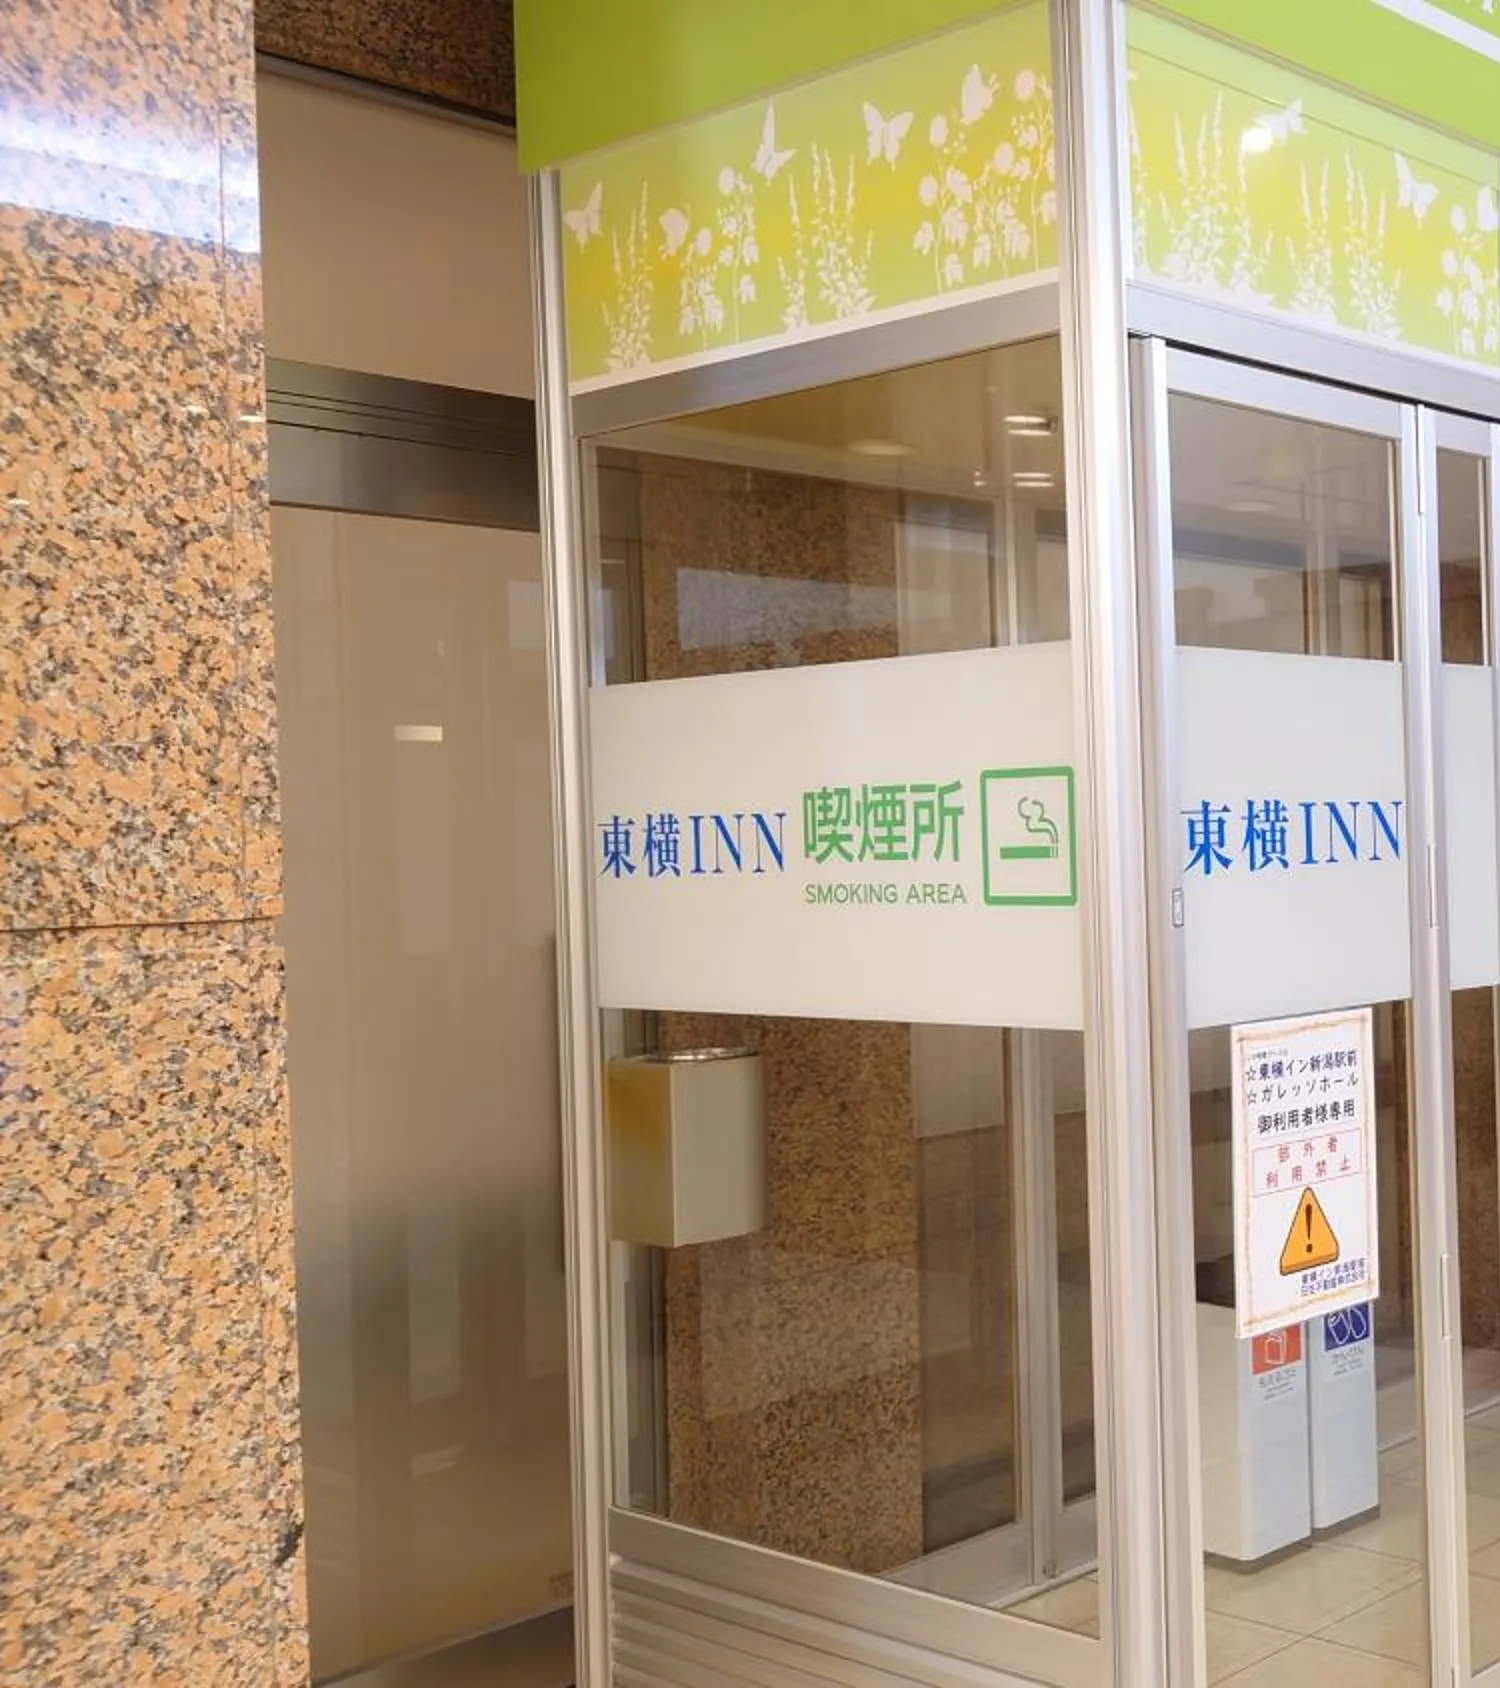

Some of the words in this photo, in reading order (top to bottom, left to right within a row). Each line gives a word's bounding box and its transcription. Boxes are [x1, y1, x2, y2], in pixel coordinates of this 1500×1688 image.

[597, 812, 787, 879] 東横INN
[802, 779, 966, 865] 喫煙所
[1180, 799, 1403, 876] 東横INN
[804, 883, 898, 905] SMOKING
[905, 883, 967, 904] AREA
